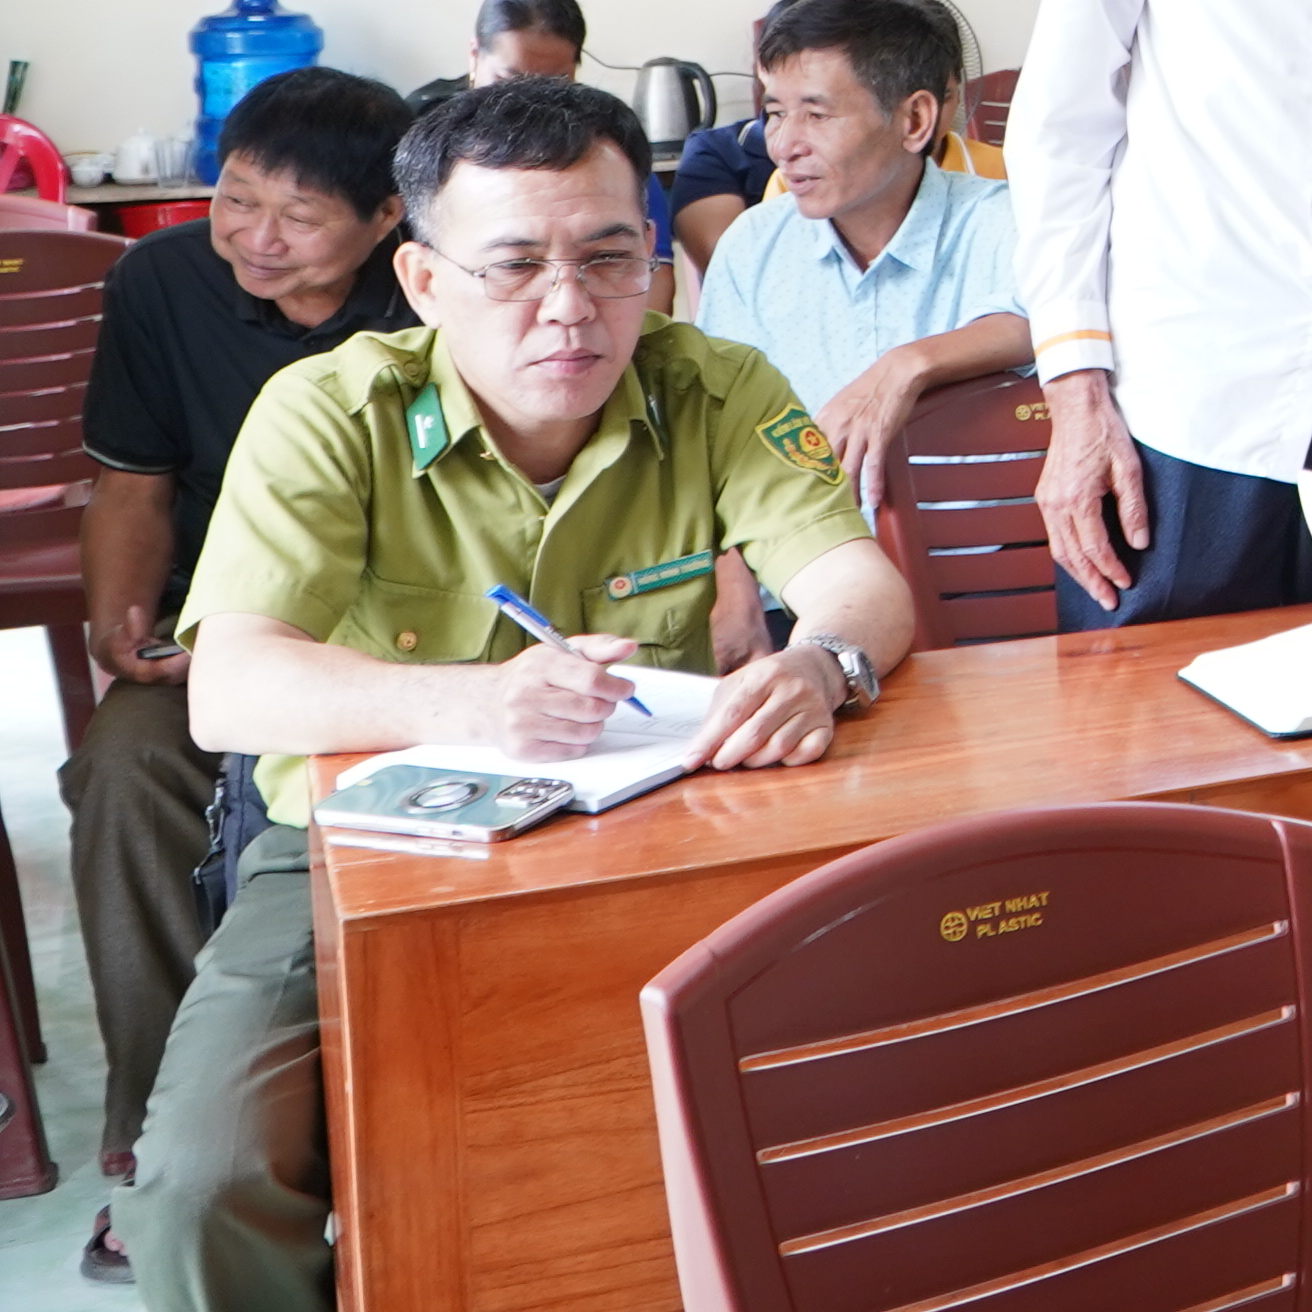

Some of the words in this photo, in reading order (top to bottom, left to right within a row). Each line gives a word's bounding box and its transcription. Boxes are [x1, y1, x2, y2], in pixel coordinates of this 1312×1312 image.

[966, 901, 1002, 921] VIET
[1005, 891, 1050, 913] NHAT
[976, 912, 1043, 939] PLASTIC
